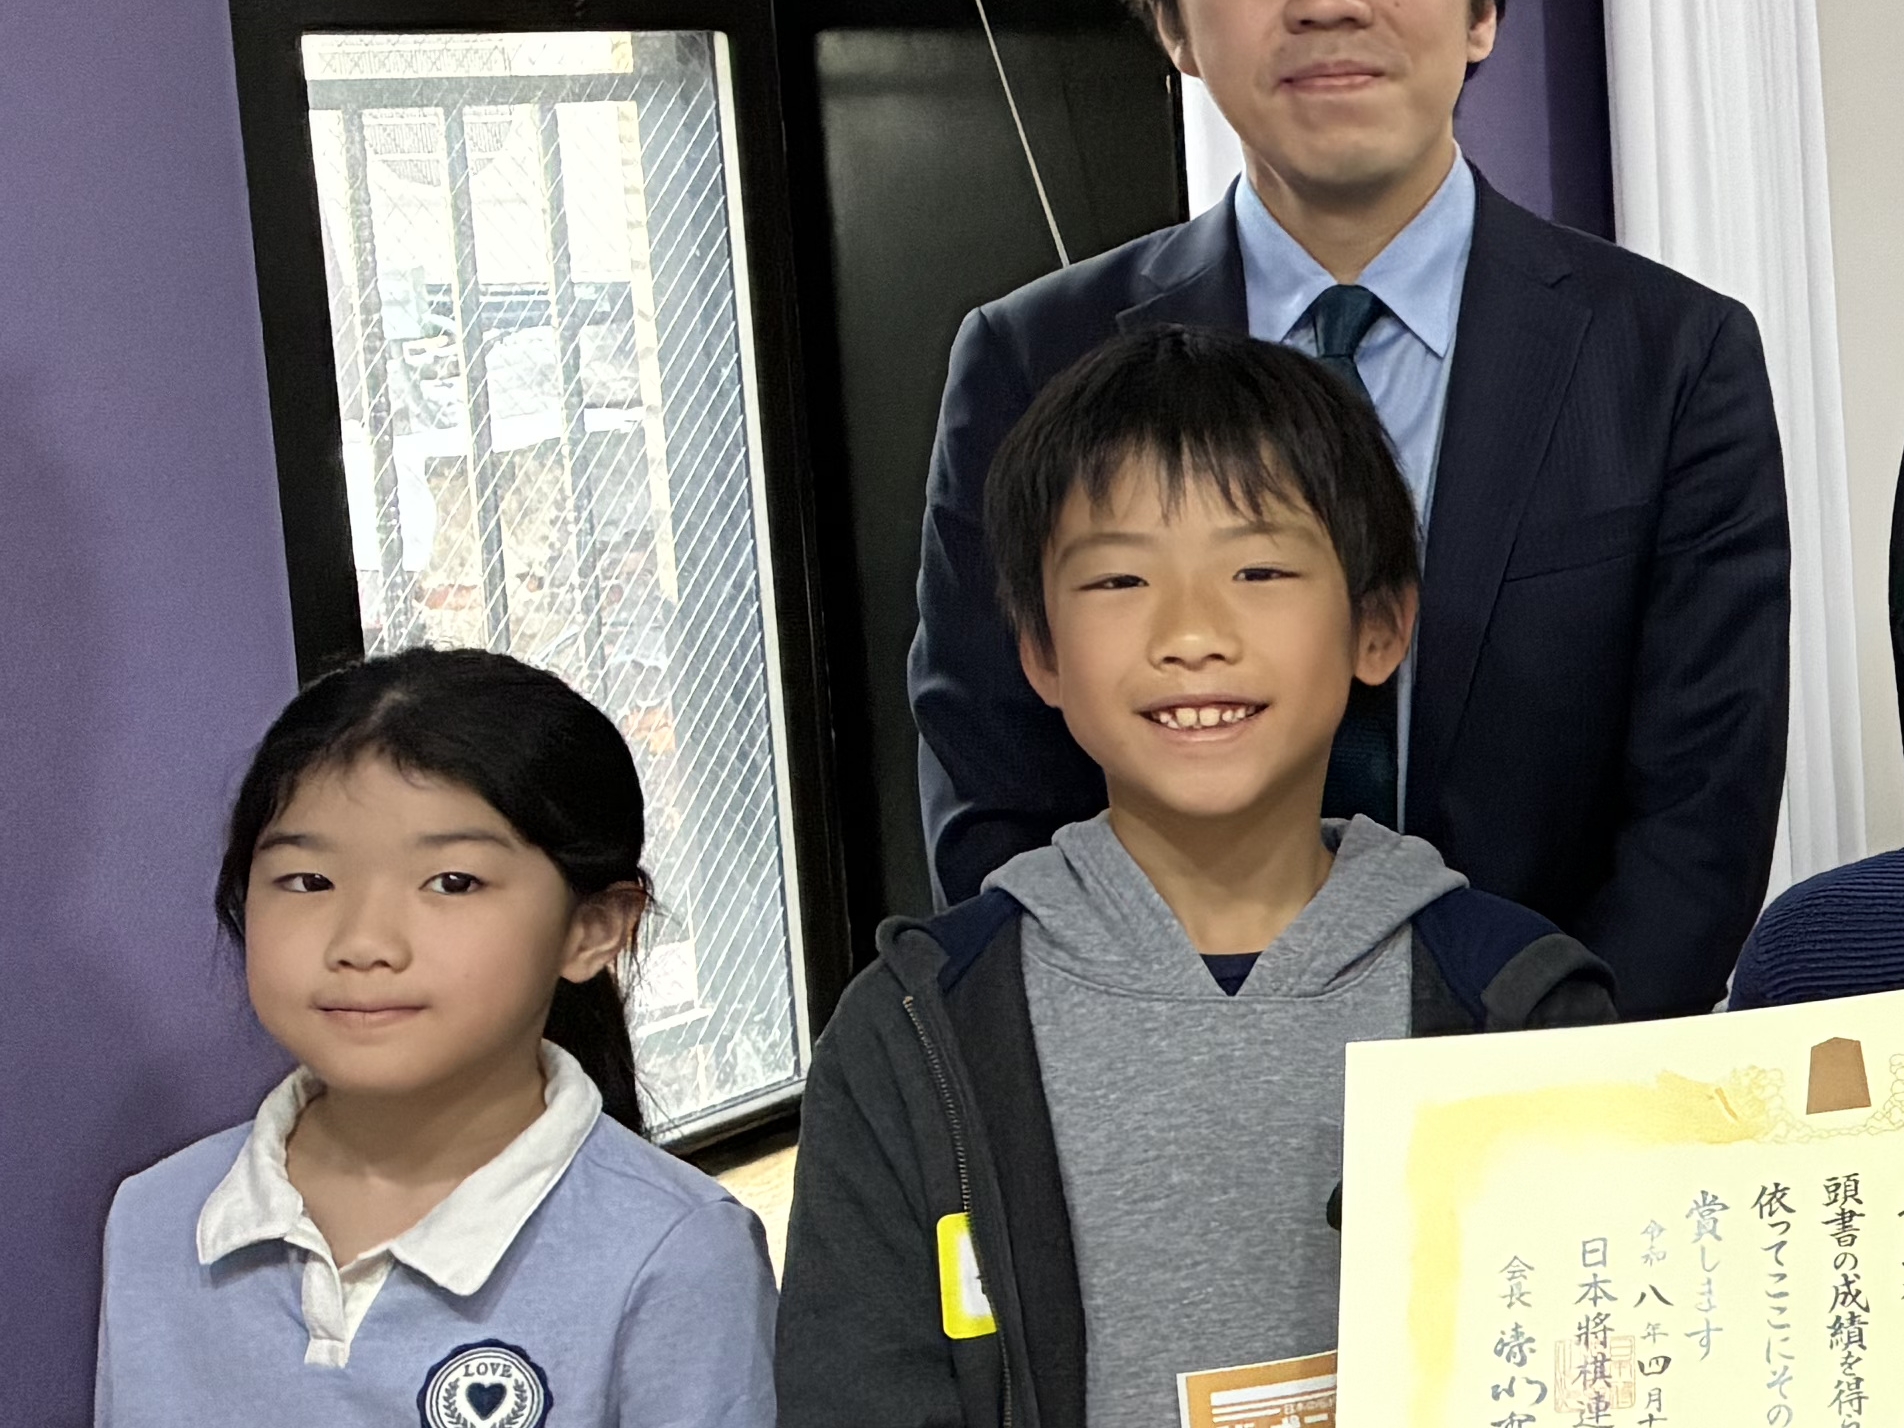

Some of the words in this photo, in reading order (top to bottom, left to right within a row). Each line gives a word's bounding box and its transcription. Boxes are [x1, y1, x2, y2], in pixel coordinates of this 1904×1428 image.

[1684, 1190, 1731, 1362] 賞します
[462, 1362, 513, 1378] LOVE
